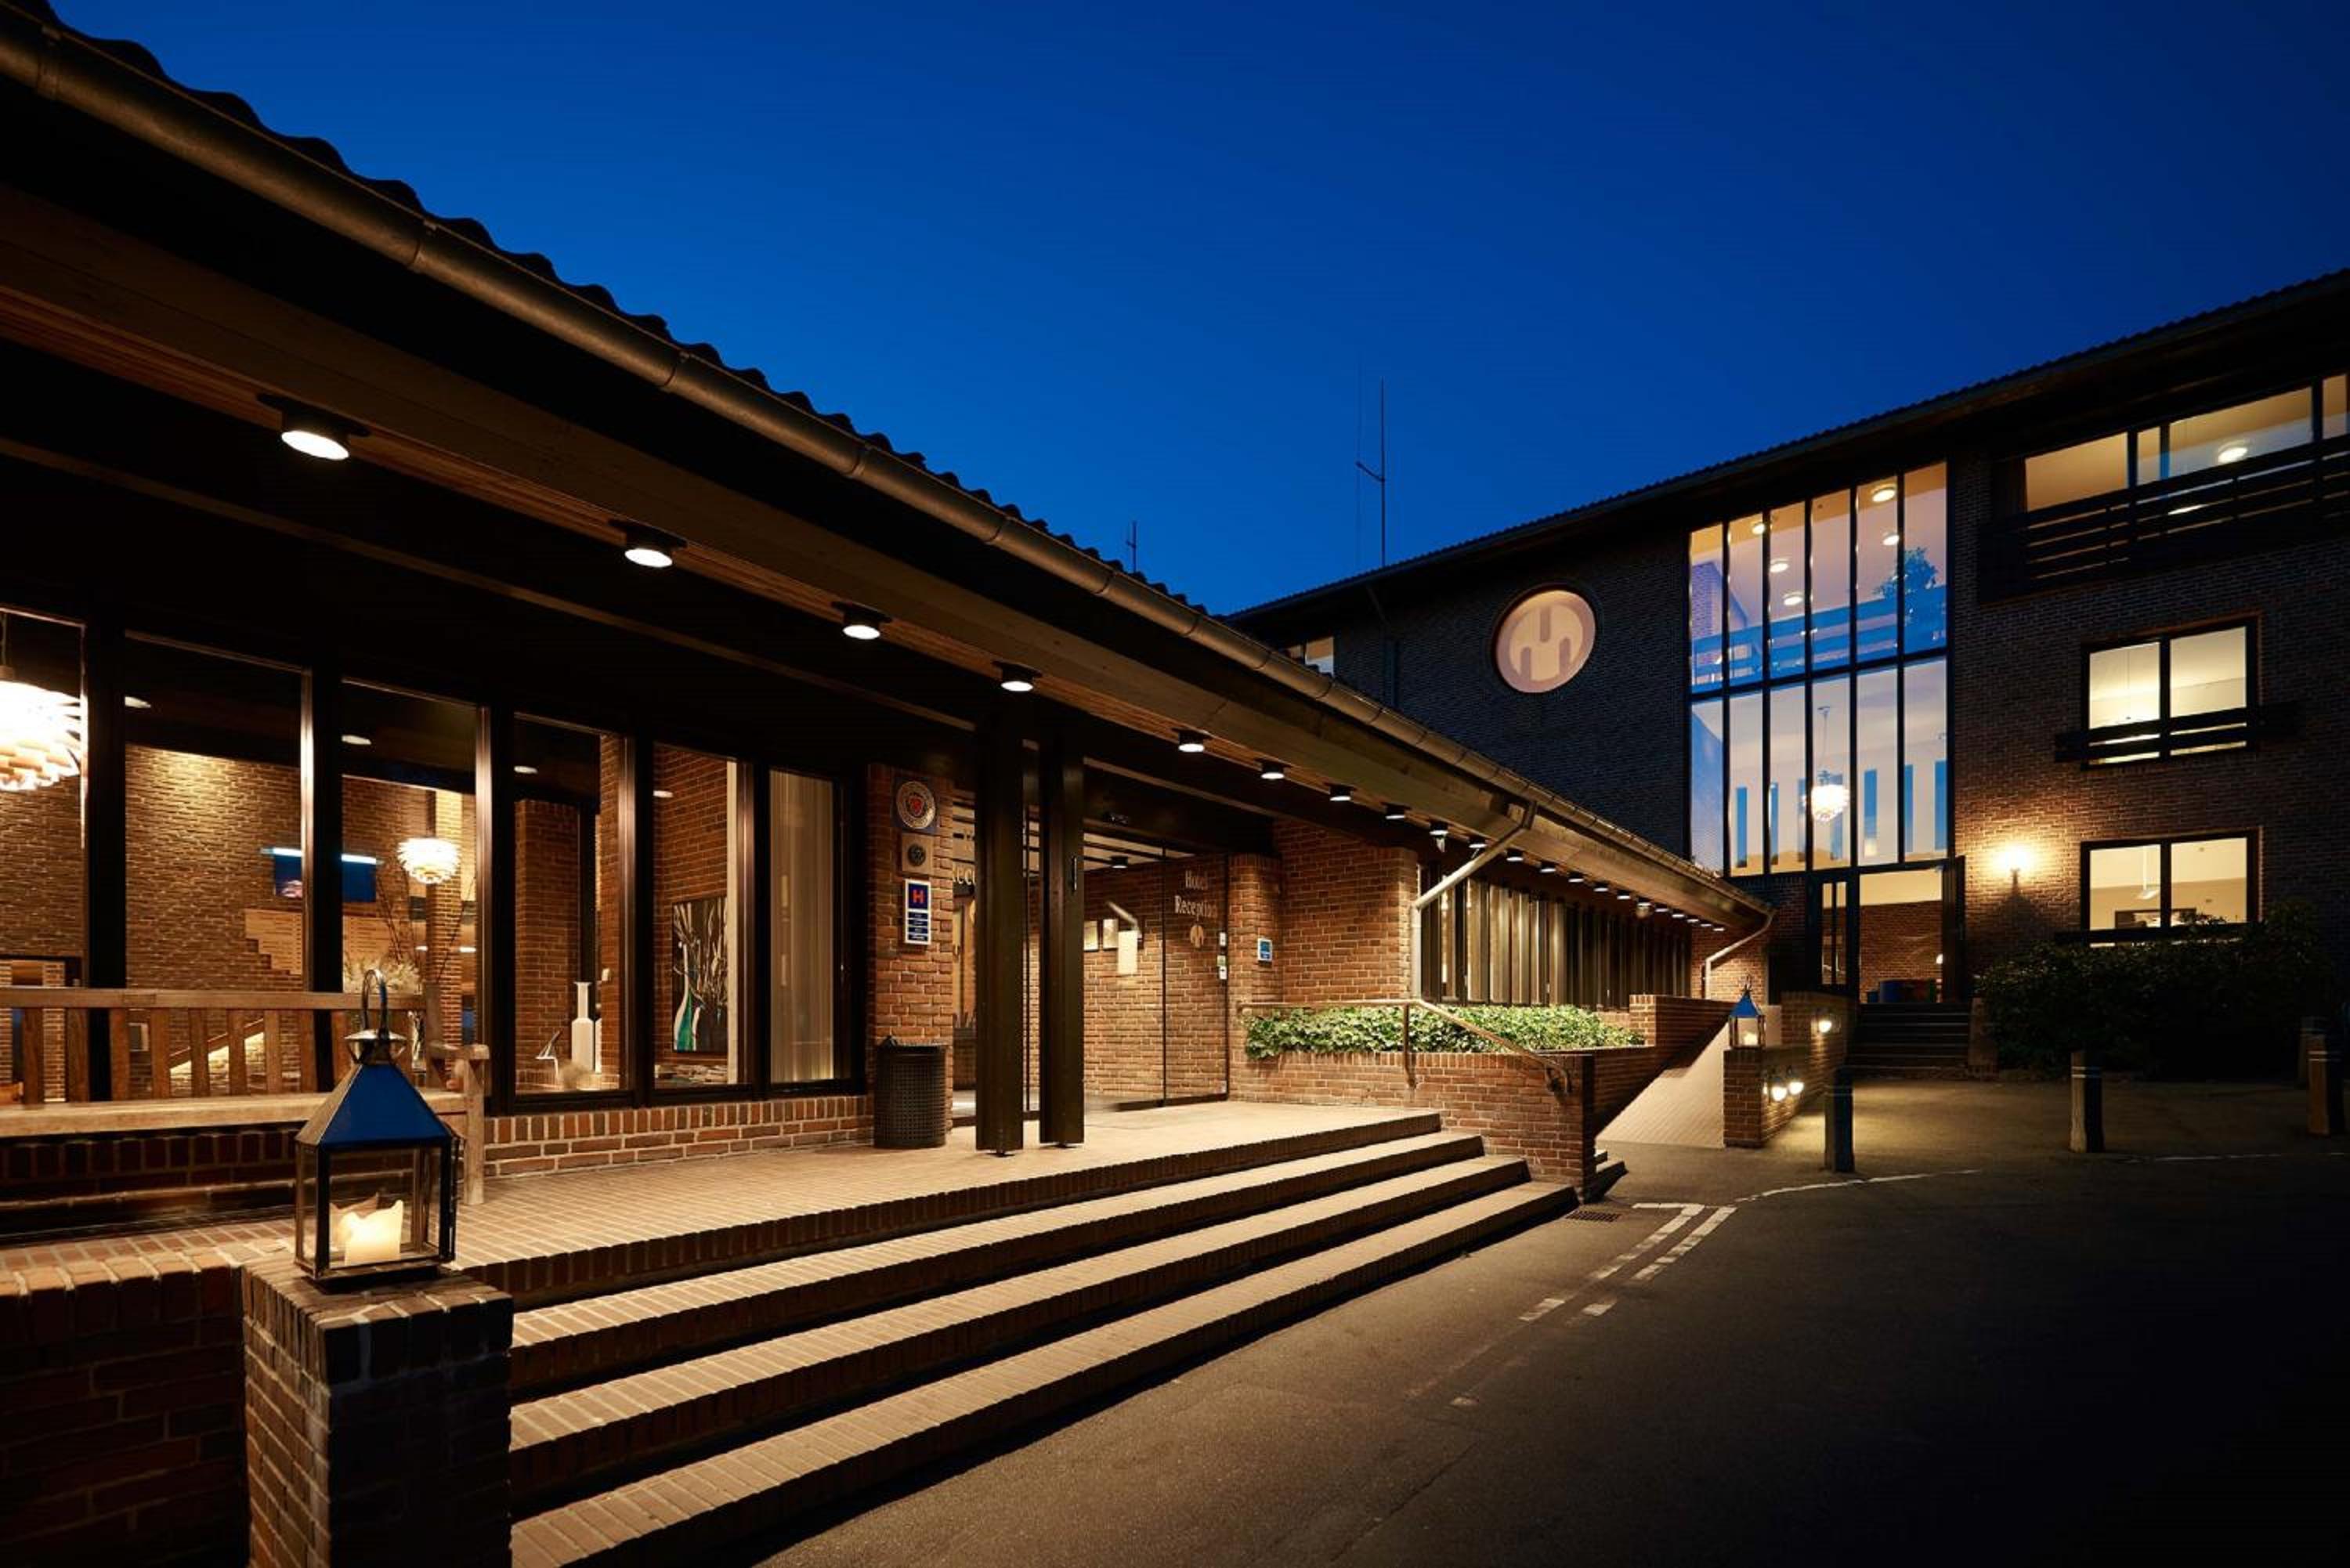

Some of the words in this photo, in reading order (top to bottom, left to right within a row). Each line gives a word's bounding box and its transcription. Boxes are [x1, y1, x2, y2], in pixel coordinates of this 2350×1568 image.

[1185, 869, 1209, 890] Hotel
[913, 889, 924, 904] H
[1174, 895, 1217, 921] Reception
